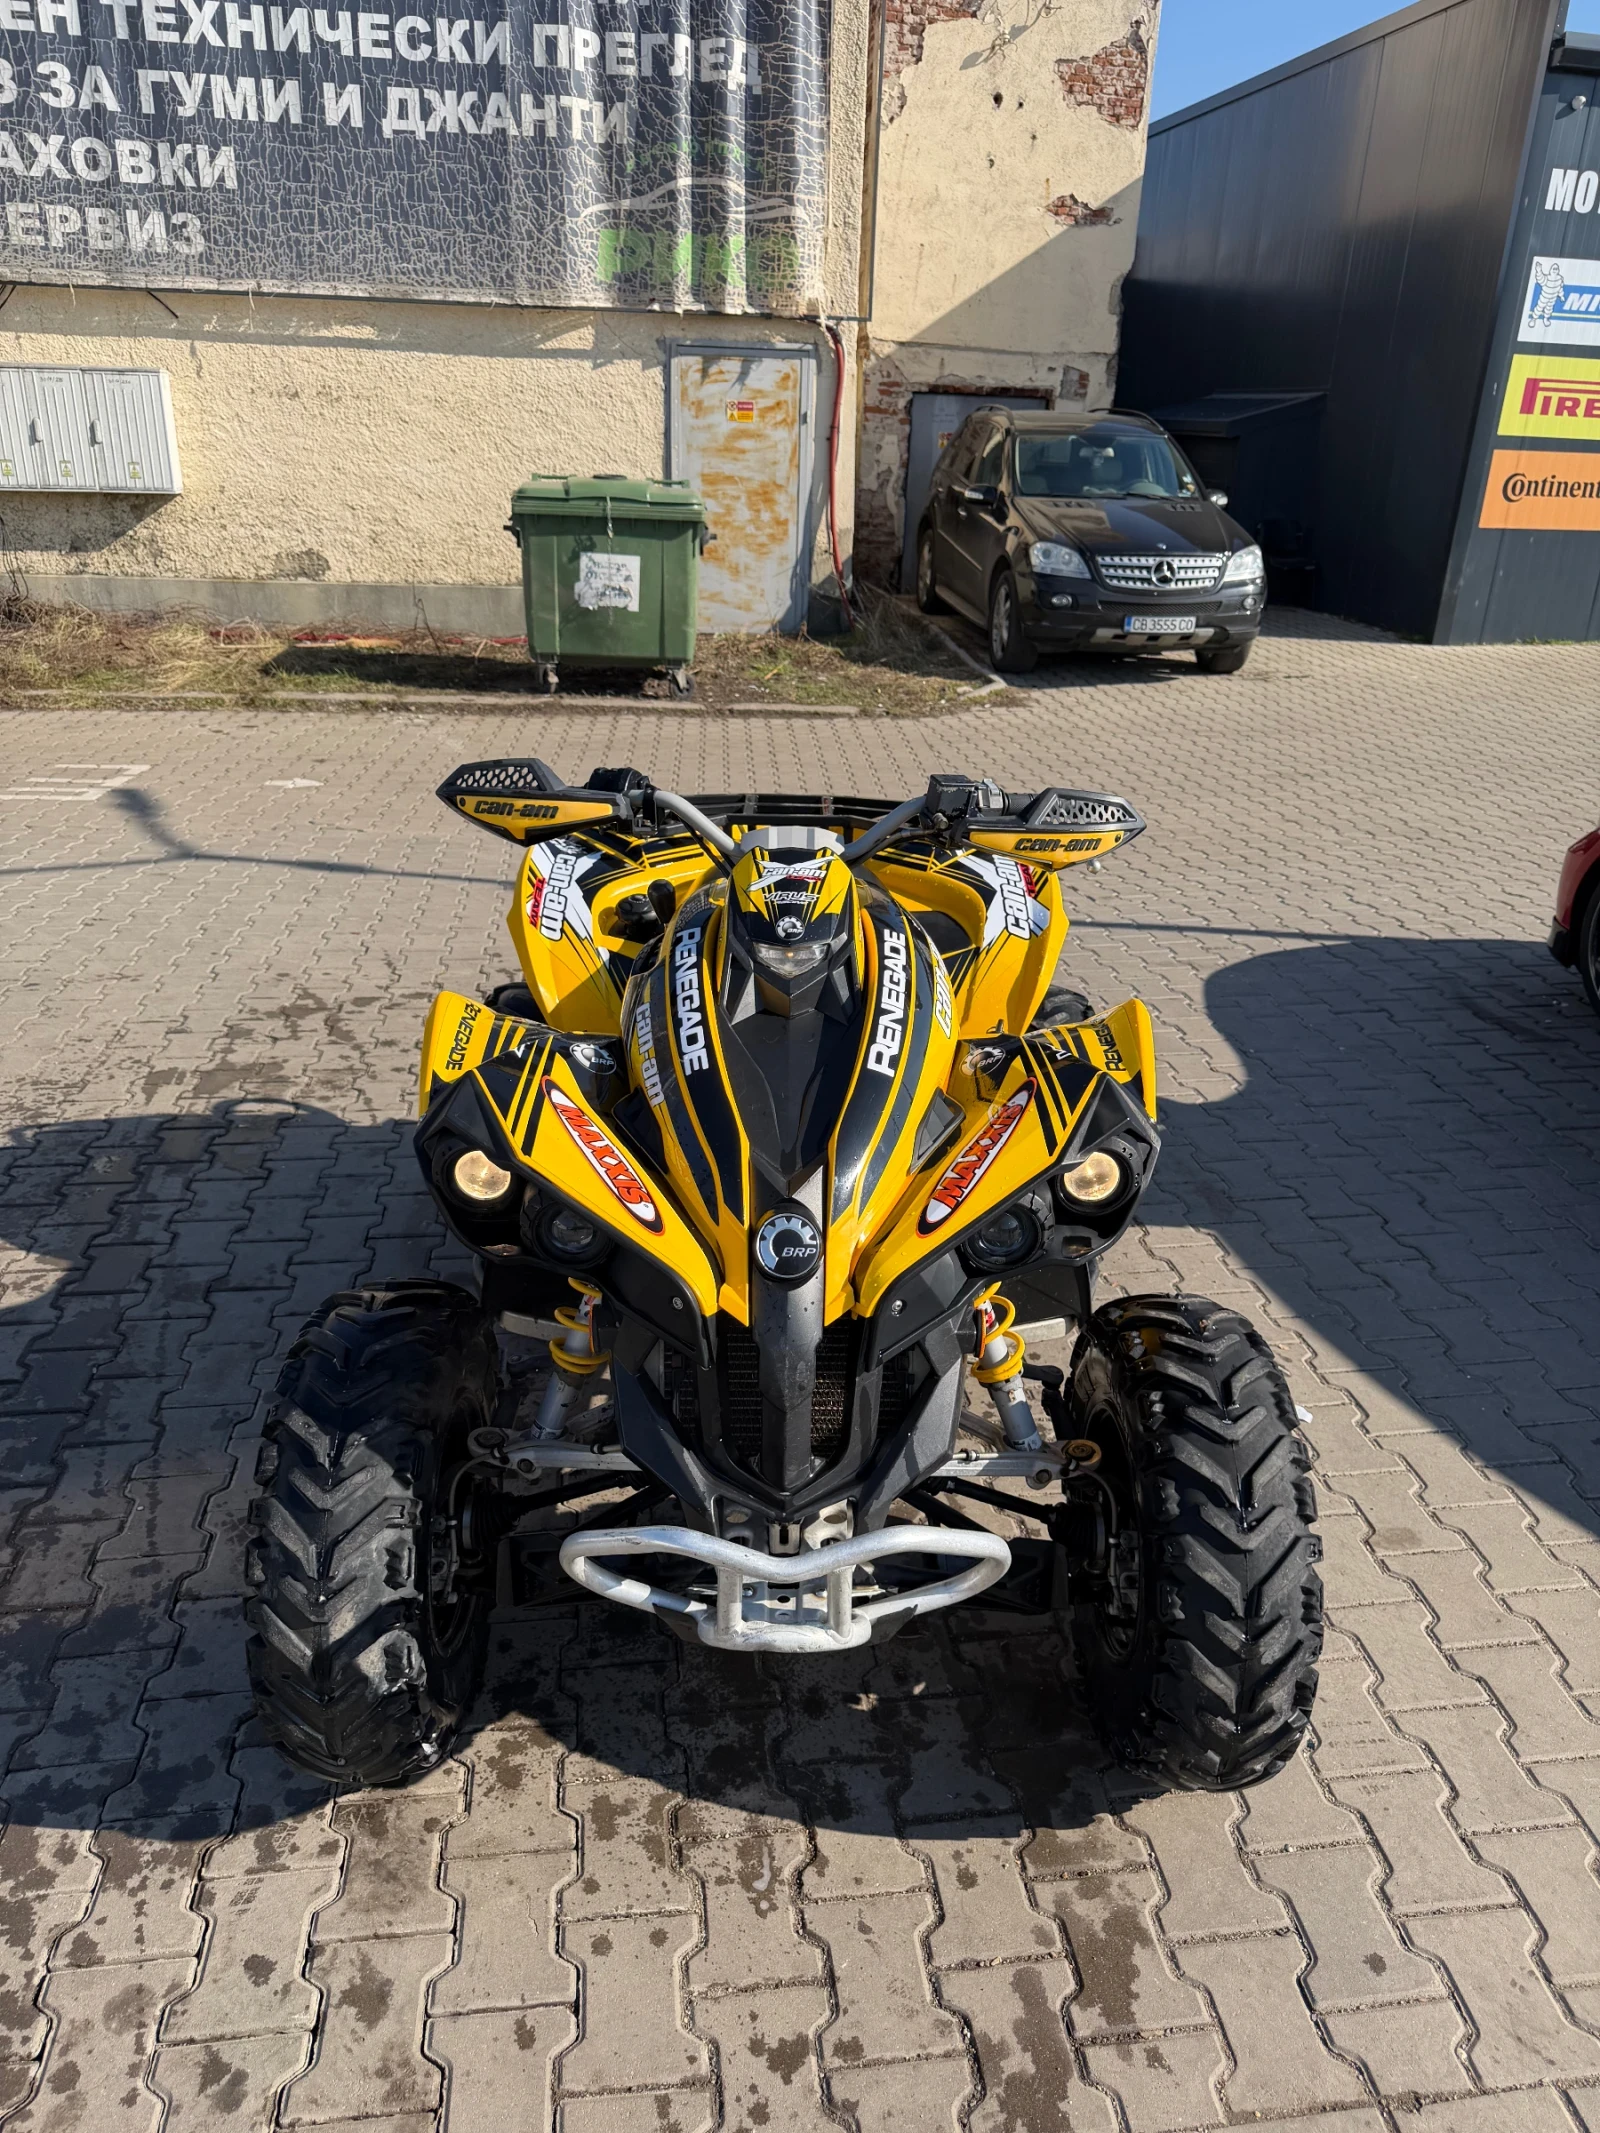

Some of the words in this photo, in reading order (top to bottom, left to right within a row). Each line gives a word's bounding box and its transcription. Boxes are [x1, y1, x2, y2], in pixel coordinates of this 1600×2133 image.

[99, 0, 511, 65] ТЕХНИЧЕСКИ
[533, 24, 762, 95] ПРЕГЛЕД
[37, 61, 121, 112] ЗА
[137, 69, 302, 124] ГУМИ
[323, 82, 363, 128] И
[382, 87, 628, 144] ДЖАНТИ
[0, 131, 238, 190] АХОВКИ
[6, 202, 206, 254] ЕРВИЗ
[1563, 293, 1600, 312] MI
[1149, 618, 1177, 631] 3555
[474, 799, 559, 819] can-am
[762, 867, 827, 878] can-am
[1014, 837, 1101, 853] can-am
[540, 853, 577, 942] can-am
[674, 926, 709, 1076] RENEGADE
[867, 928, 907, 1078] RENEGADE
[445, 1003, 482, 1071] RENEGADE
[636, 1002, 665, 1108] can-am
[553, 1102, 652, 1205] MAXXIS
[937, 1103, 1024, 1208] MAXXIS
[781, 1246, 817, 1257] BRP
